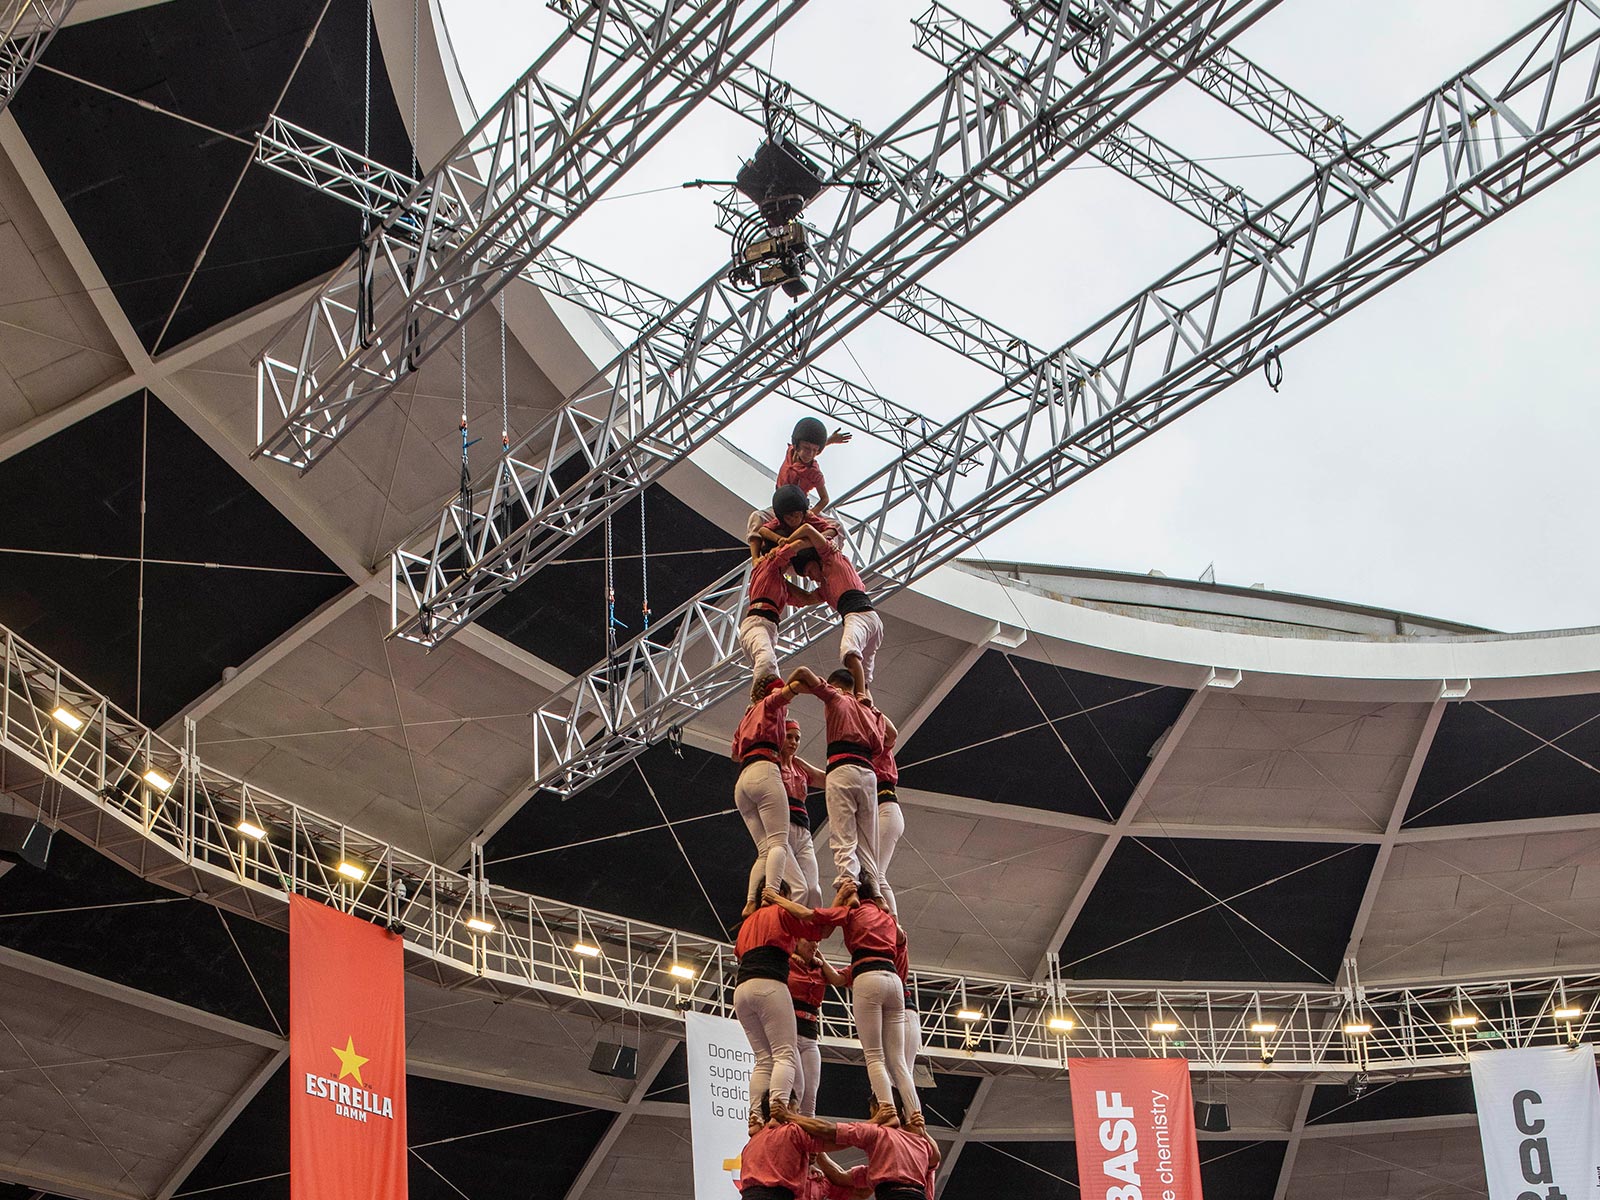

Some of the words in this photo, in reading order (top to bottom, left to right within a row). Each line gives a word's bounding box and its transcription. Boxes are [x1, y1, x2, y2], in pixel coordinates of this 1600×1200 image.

[708, 1043, 756, 1063] Donem
[305, 1072, 394, 1119] ESTRELLA
[335, 1103, 367, 1123] DAMM
[712, 1101, 724, 1117] la
[1151, 1090, 1174, 1184] chemistry
